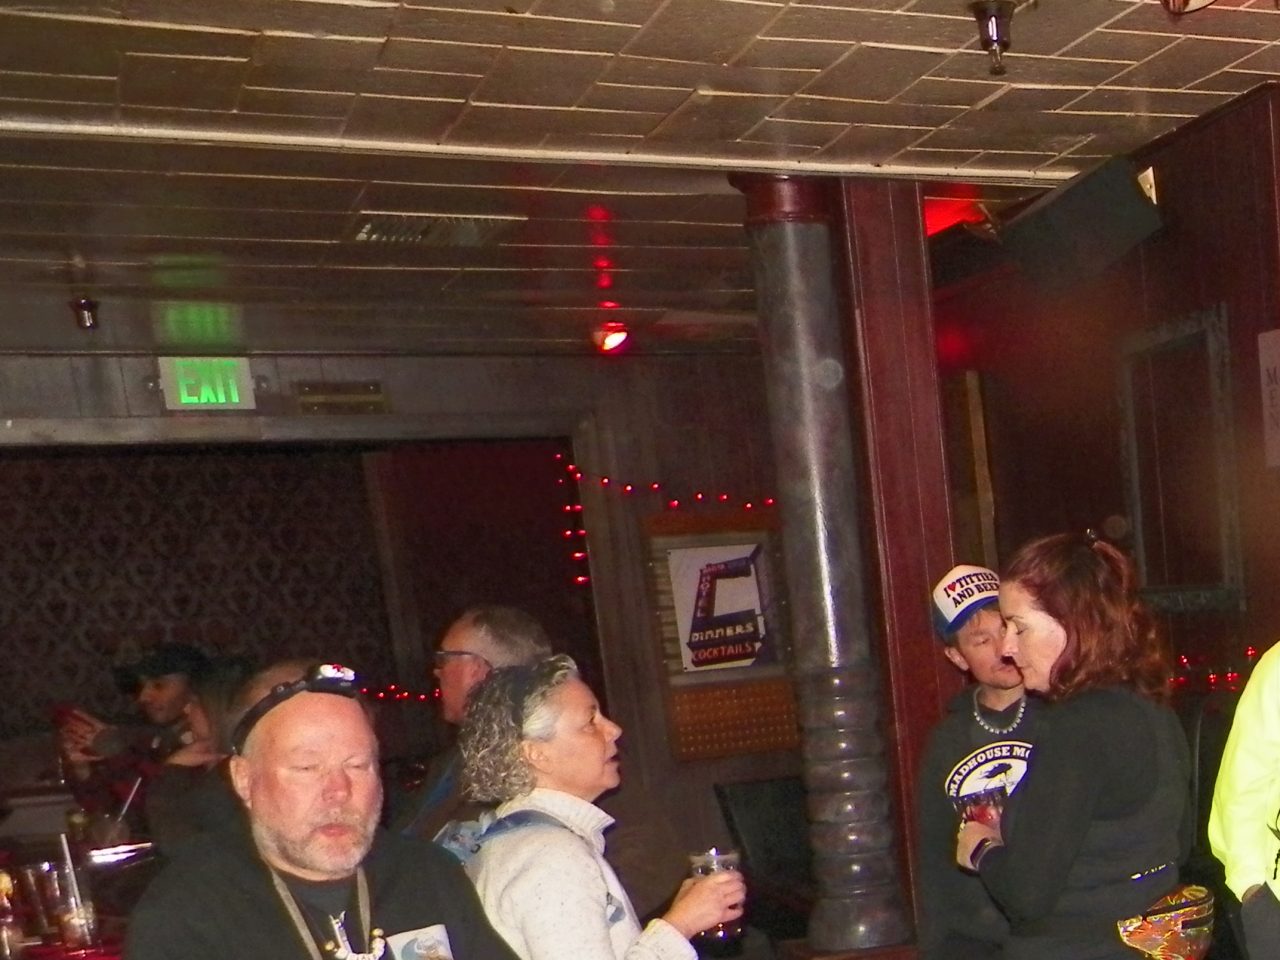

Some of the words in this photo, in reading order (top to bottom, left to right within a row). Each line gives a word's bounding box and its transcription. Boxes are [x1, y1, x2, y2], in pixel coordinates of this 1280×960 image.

[176, 361, 240, 404] EXIT
[1265, 366, 1280, 430] MEN
[943, 587, 951, 598] I
[952, 587, 975, 608] AND
[691, 622, 754, 641] DINNERS
[693, 642, 753, 660] COCKTAILS
[949, 746, 1010, 797] MADHOUSE
